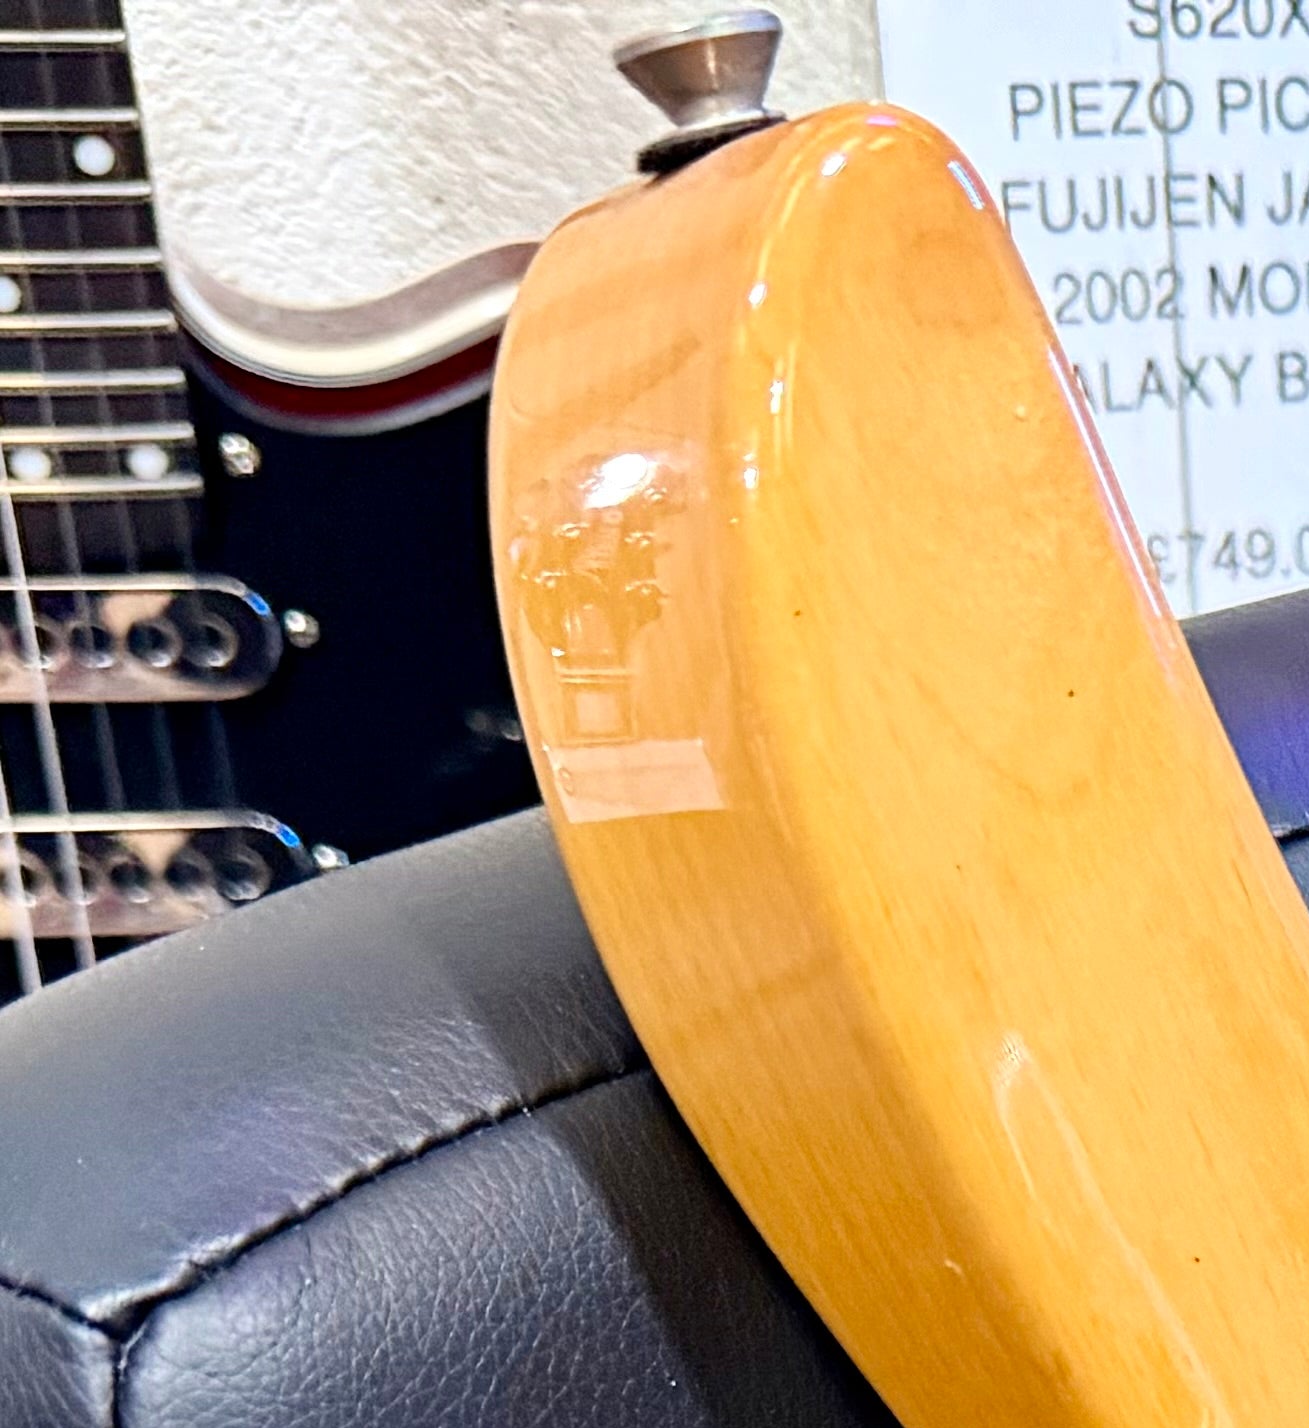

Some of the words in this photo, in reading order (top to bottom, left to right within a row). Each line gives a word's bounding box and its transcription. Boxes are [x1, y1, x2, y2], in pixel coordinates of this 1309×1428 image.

[1008, 76, 1194, 142] PIEZO
[1001, 172, 1245, 234] FUJIJEN
[1054, 267, 1183, 326] 2002
